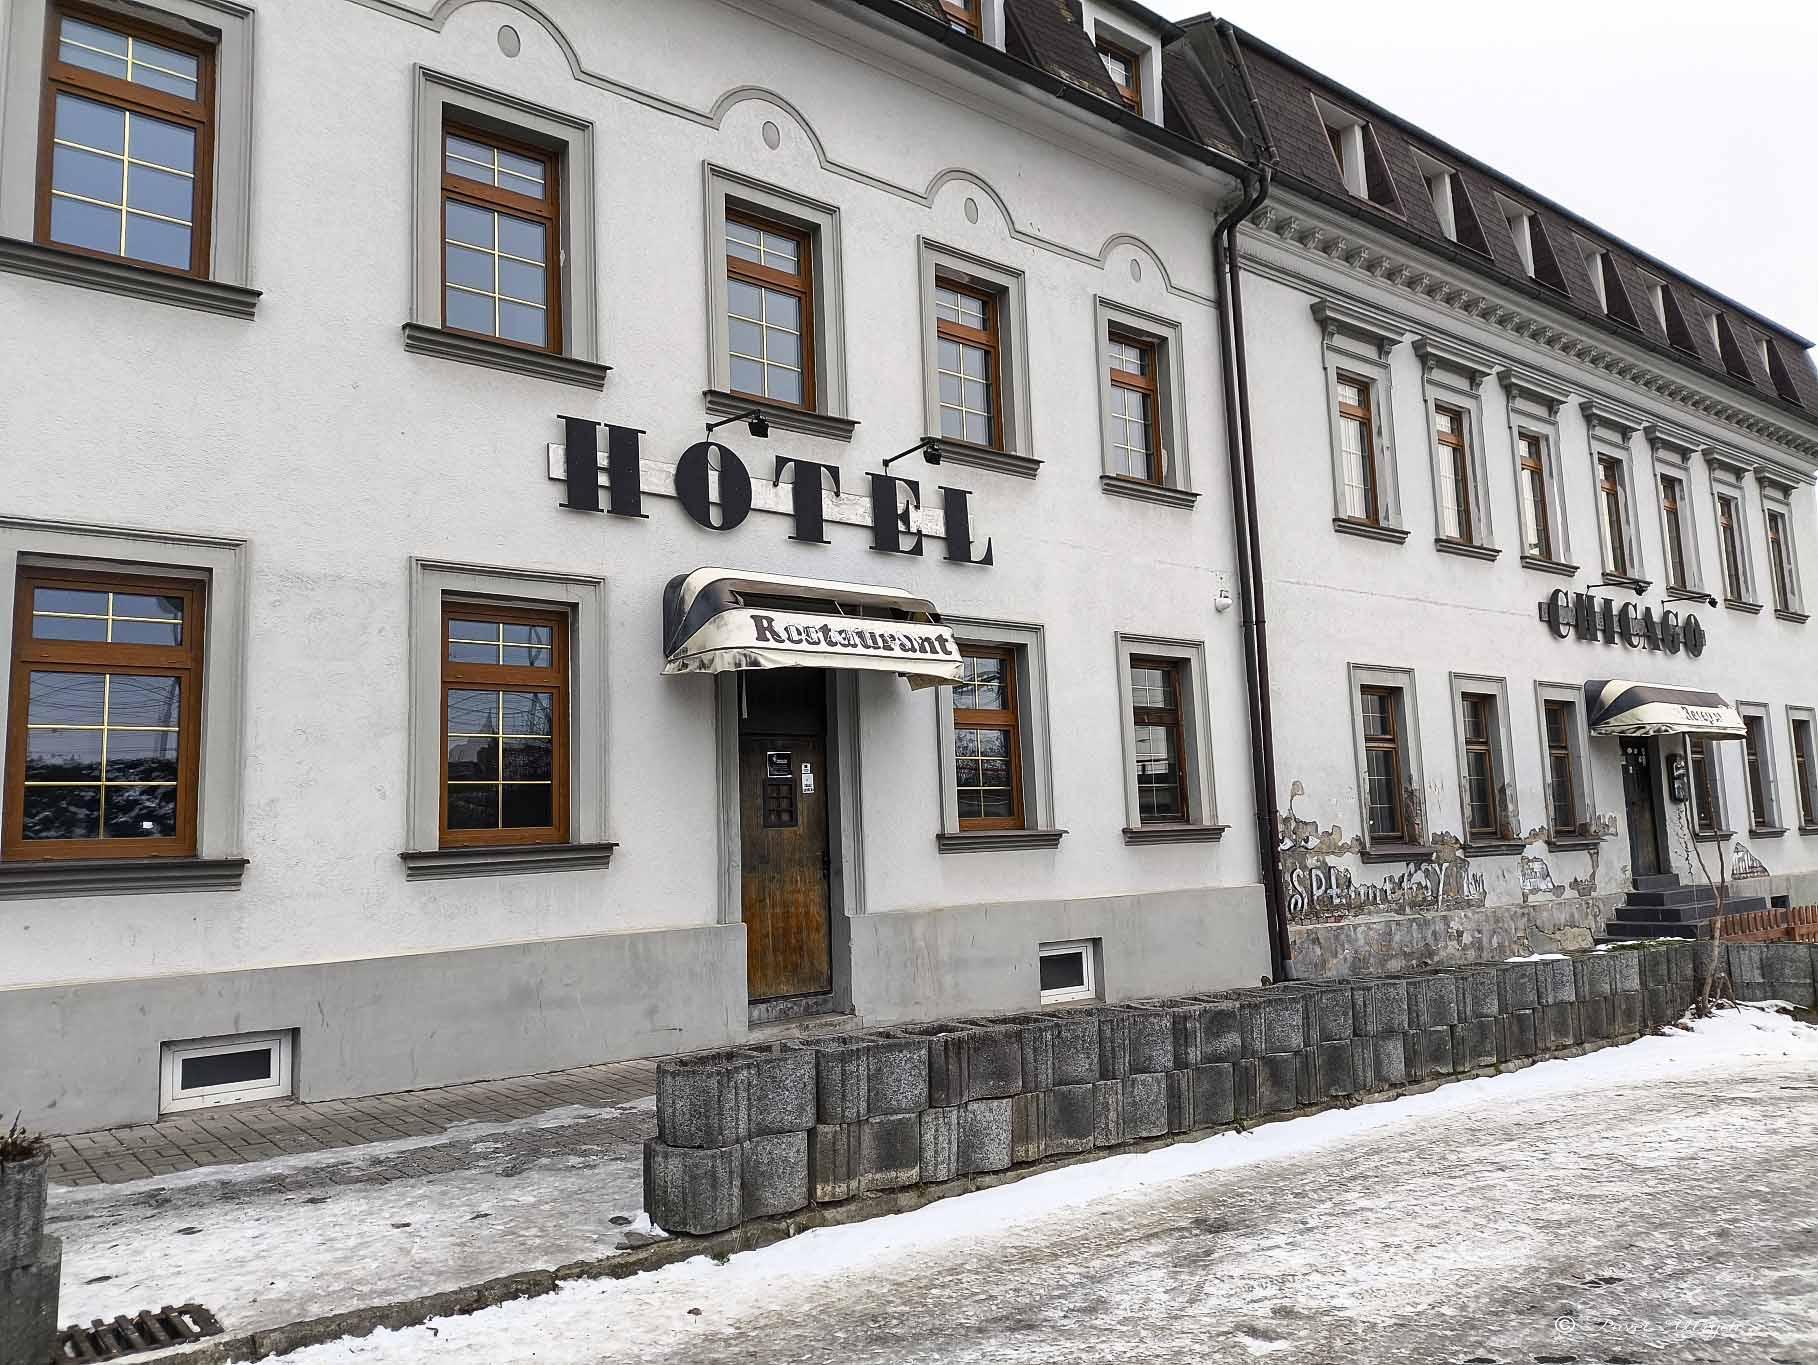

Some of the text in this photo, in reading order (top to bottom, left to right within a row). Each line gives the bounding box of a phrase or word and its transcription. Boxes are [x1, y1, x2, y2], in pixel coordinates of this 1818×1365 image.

[556, 414, 994, 566] HOTEL
[750, 614, 953, 655] Restaurant
[1549, 588, 1704, 658] CHICAGO
